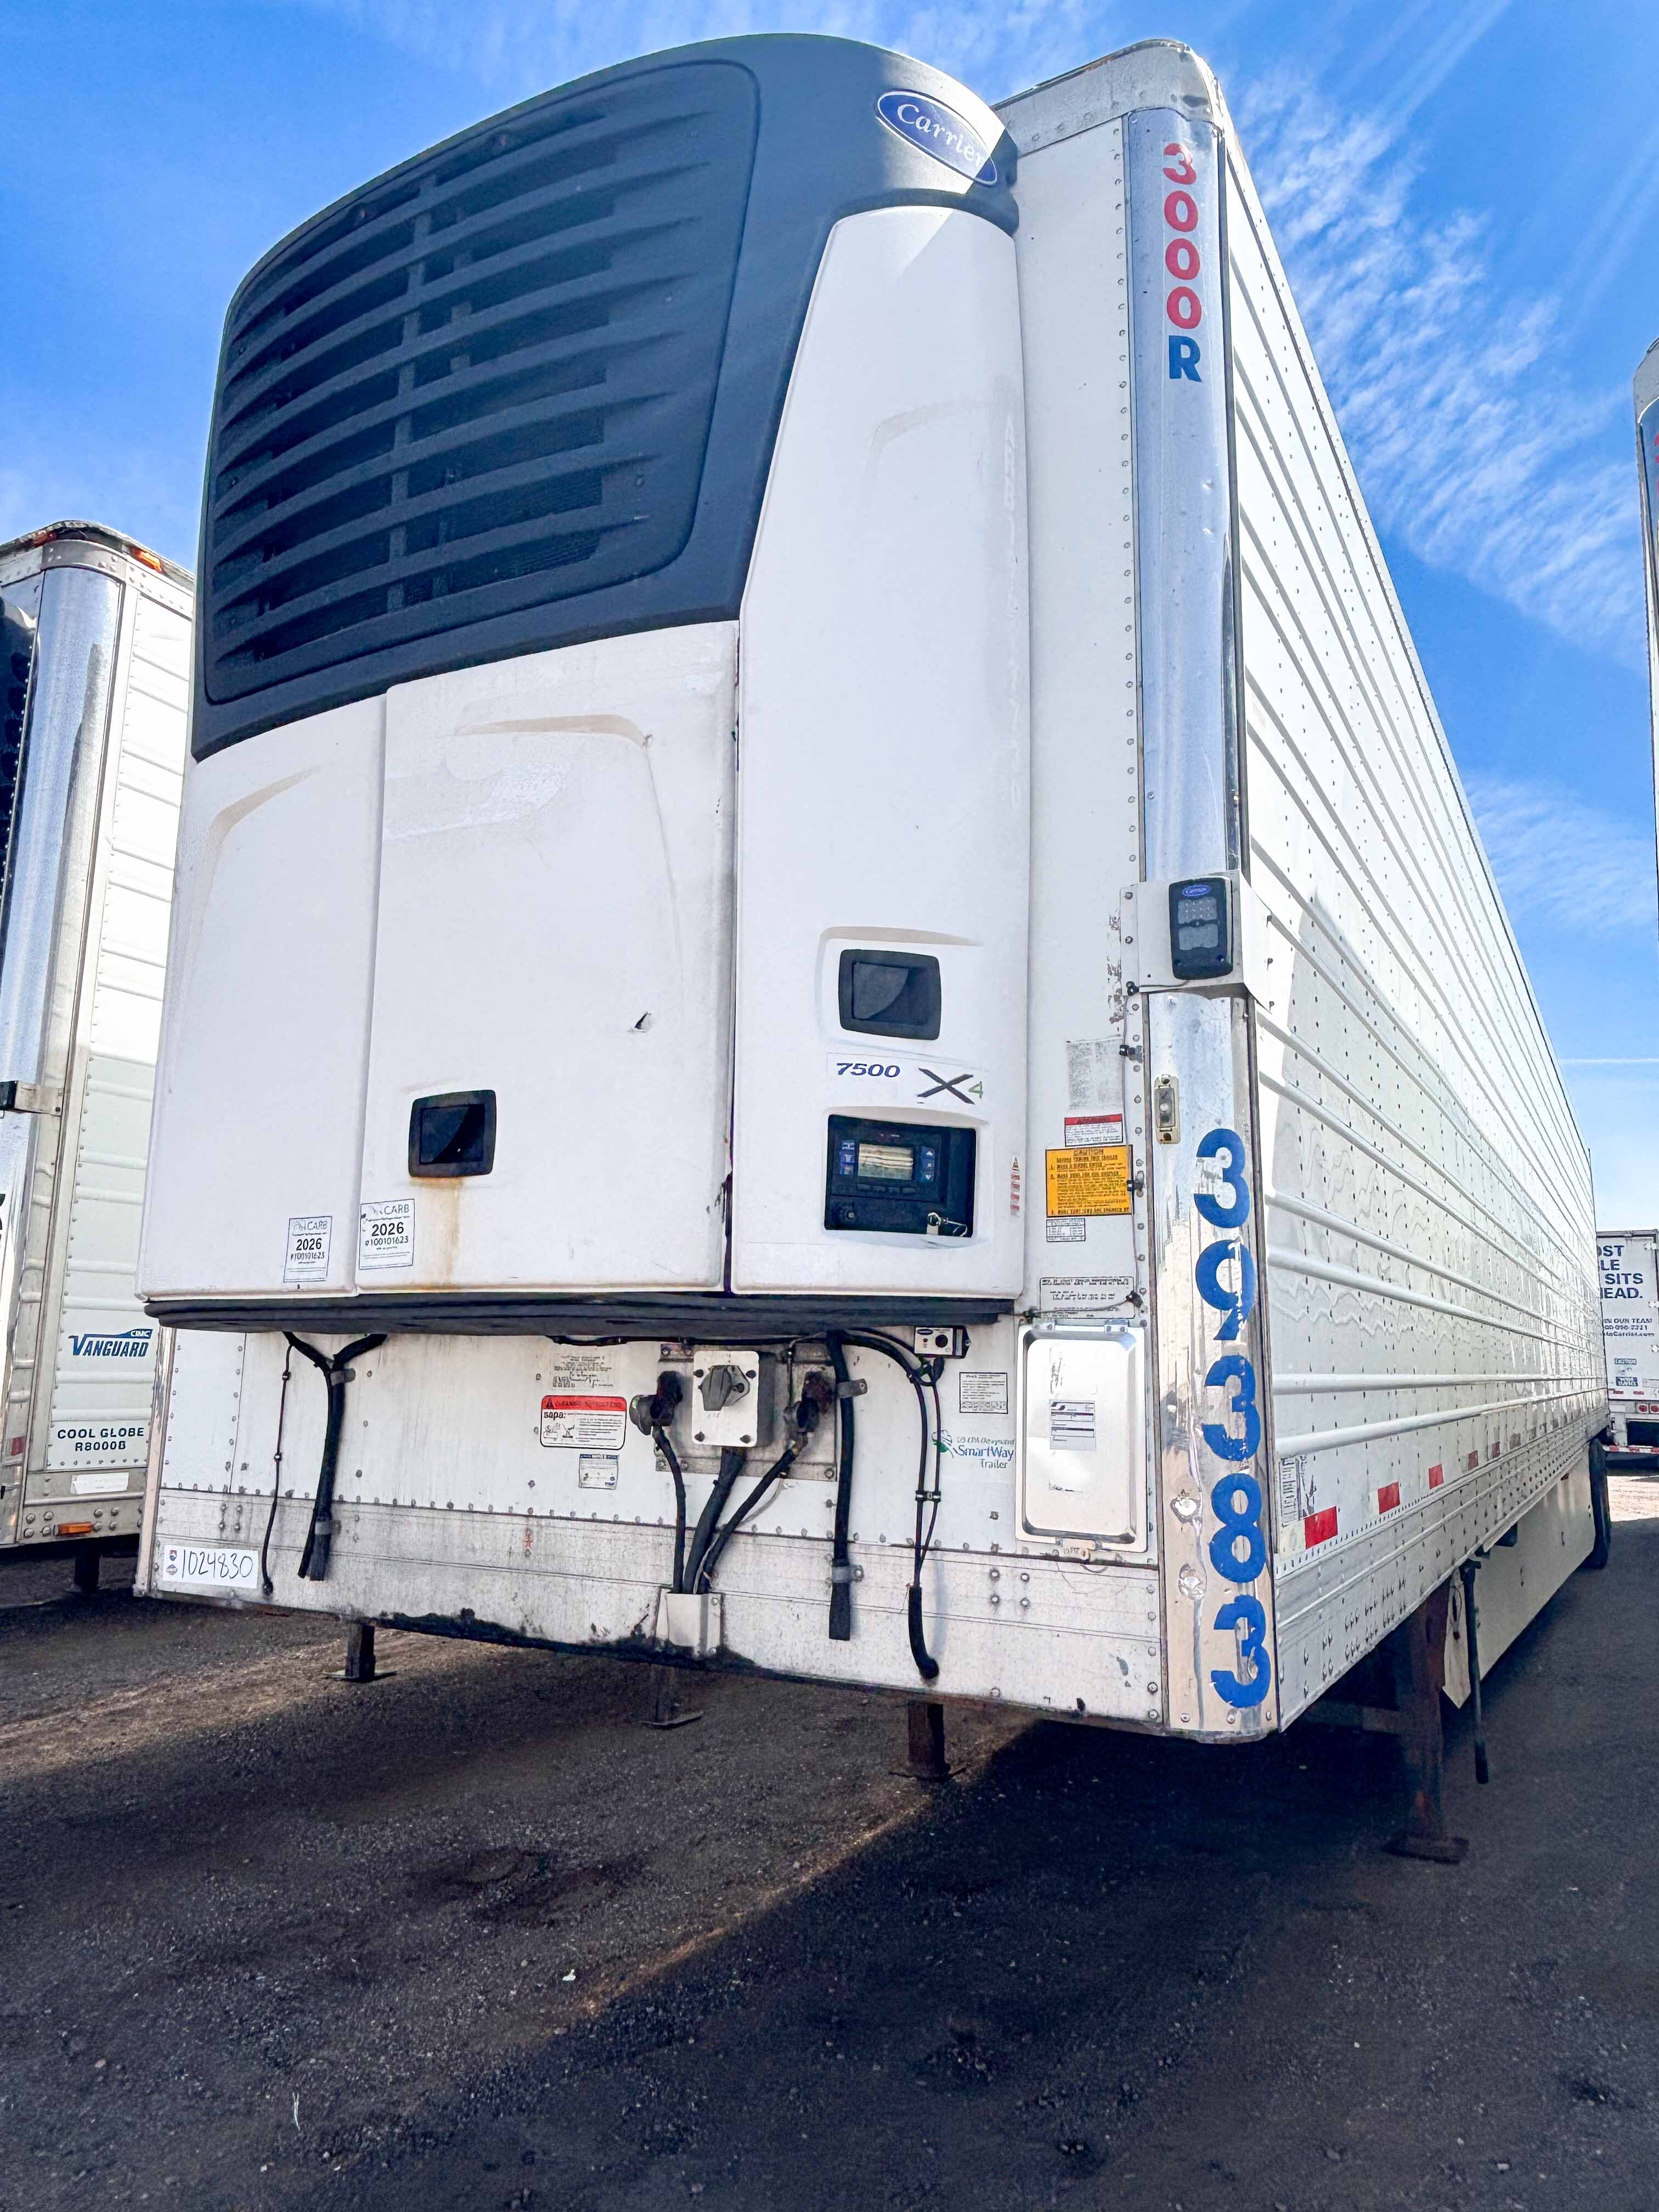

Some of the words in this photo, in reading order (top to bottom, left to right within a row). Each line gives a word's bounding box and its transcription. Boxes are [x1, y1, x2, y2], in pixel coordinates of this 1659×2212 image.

[897, 103, 984, 167] Carrier
[1163, 143, 1203, 383] 3000R
[837, 1062, 900, 1078] 7500
[383, 1204, 410, 1215] CARB
[307, 1220, 328, 1231] CARB
[371, 1222, 404, 1237] 2026
[296, 1238, 322, 1251] 2026
[1605, 1273, 1644, 1285] SITS
[68, 1334, 149, 1357] VANGUARD
[1193, 1128, 1271, 1708] 39383
[58, 1429, 95, 1439] COOL
[100, 1427, 144, 1438] GLOBE
[956, 1445, 1014, 1462] SmartWay
[980, 1459, 1008, 1469] Trailer
[182, 1549, 253, 1579] 1024830
